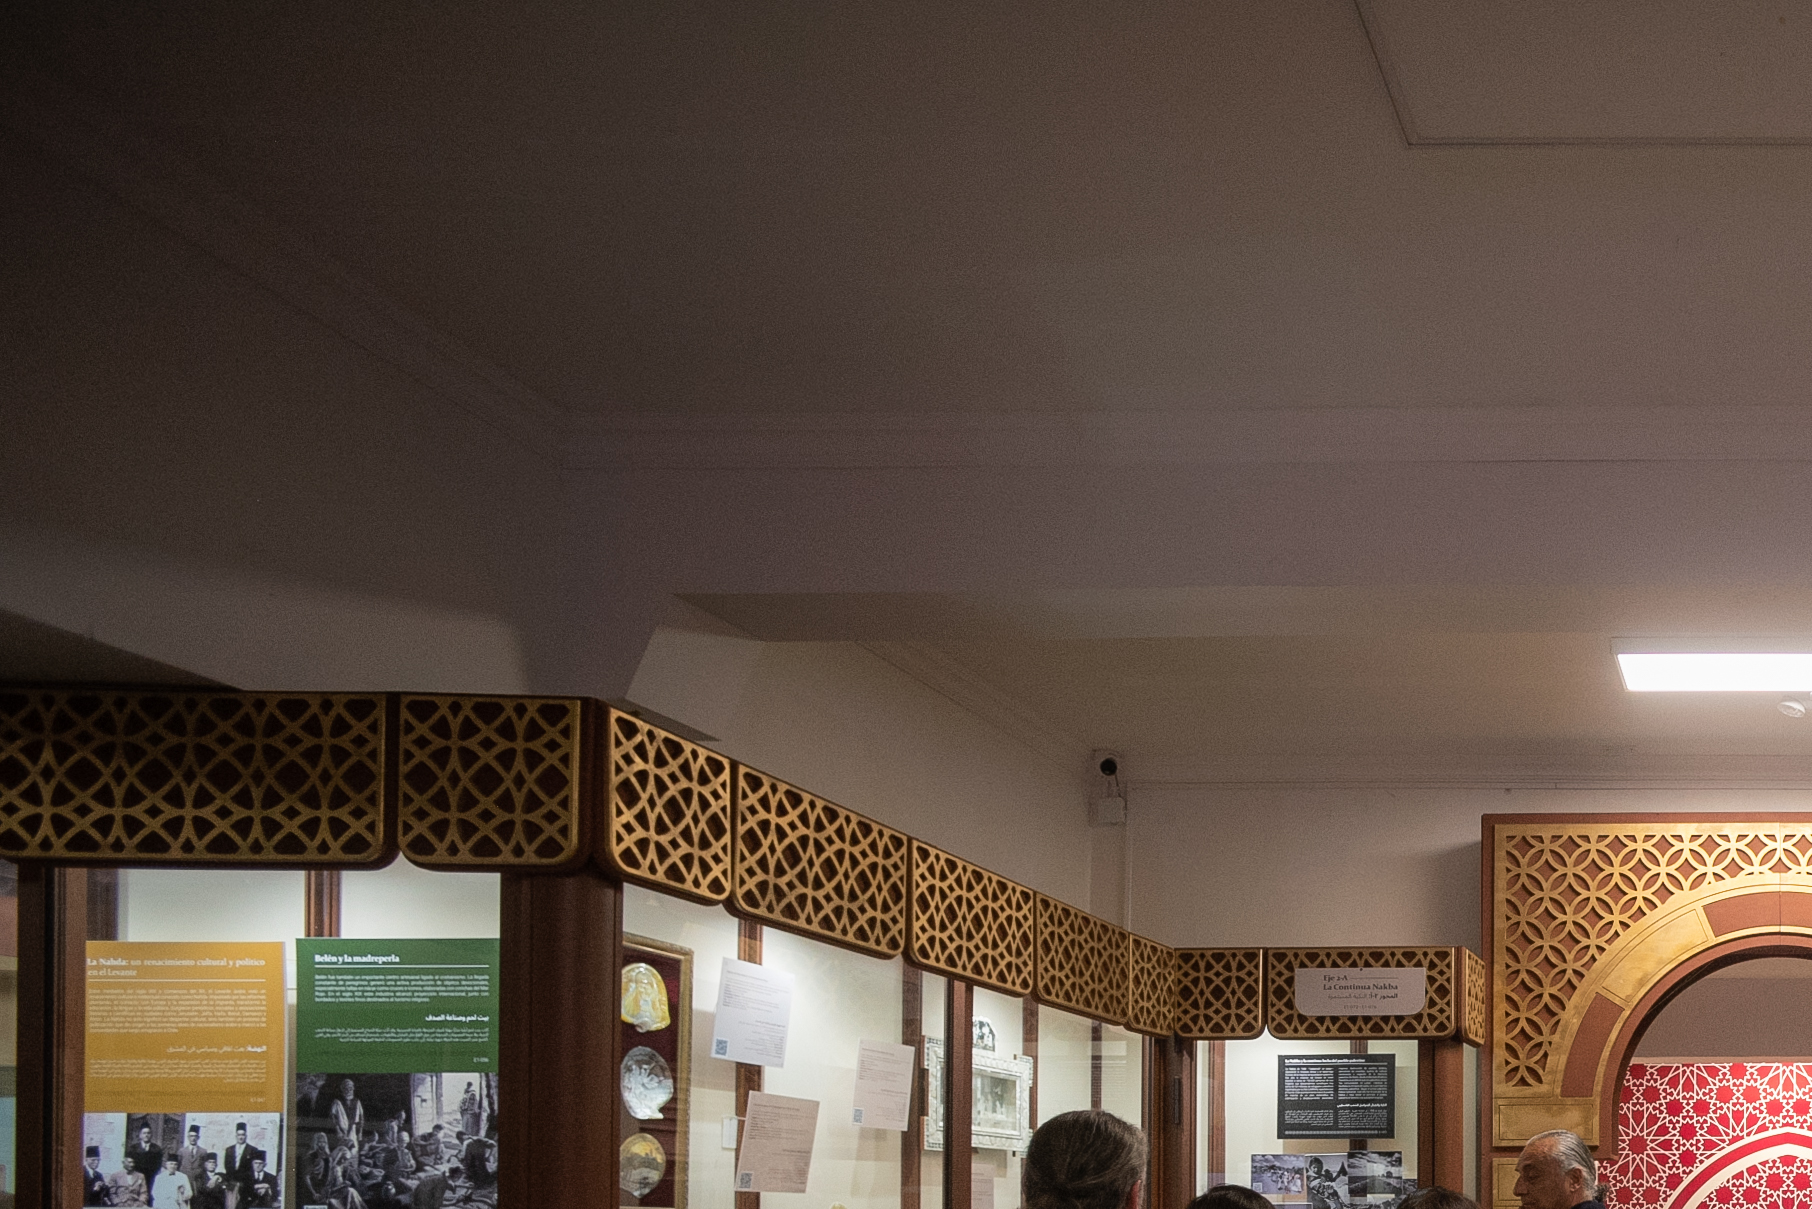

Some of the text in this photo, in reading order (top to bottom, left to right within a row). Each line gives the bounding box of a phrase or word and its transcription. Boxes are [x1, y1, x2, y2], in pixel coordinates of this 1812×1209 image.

[98, 958, 129, 966] Nahda:
[144, 958, 195, 966] renacimiento
[196, 958, 227, 966] cultural
[314, 954, 338, 963] Belén
[344, 954, 352, 963] la
[353, 954, 400, 964] madreperla
[99, 968, 107, 976] el
[108, 968, 138, 976] Levante
[1323, 974, 1336, 982] Eje
